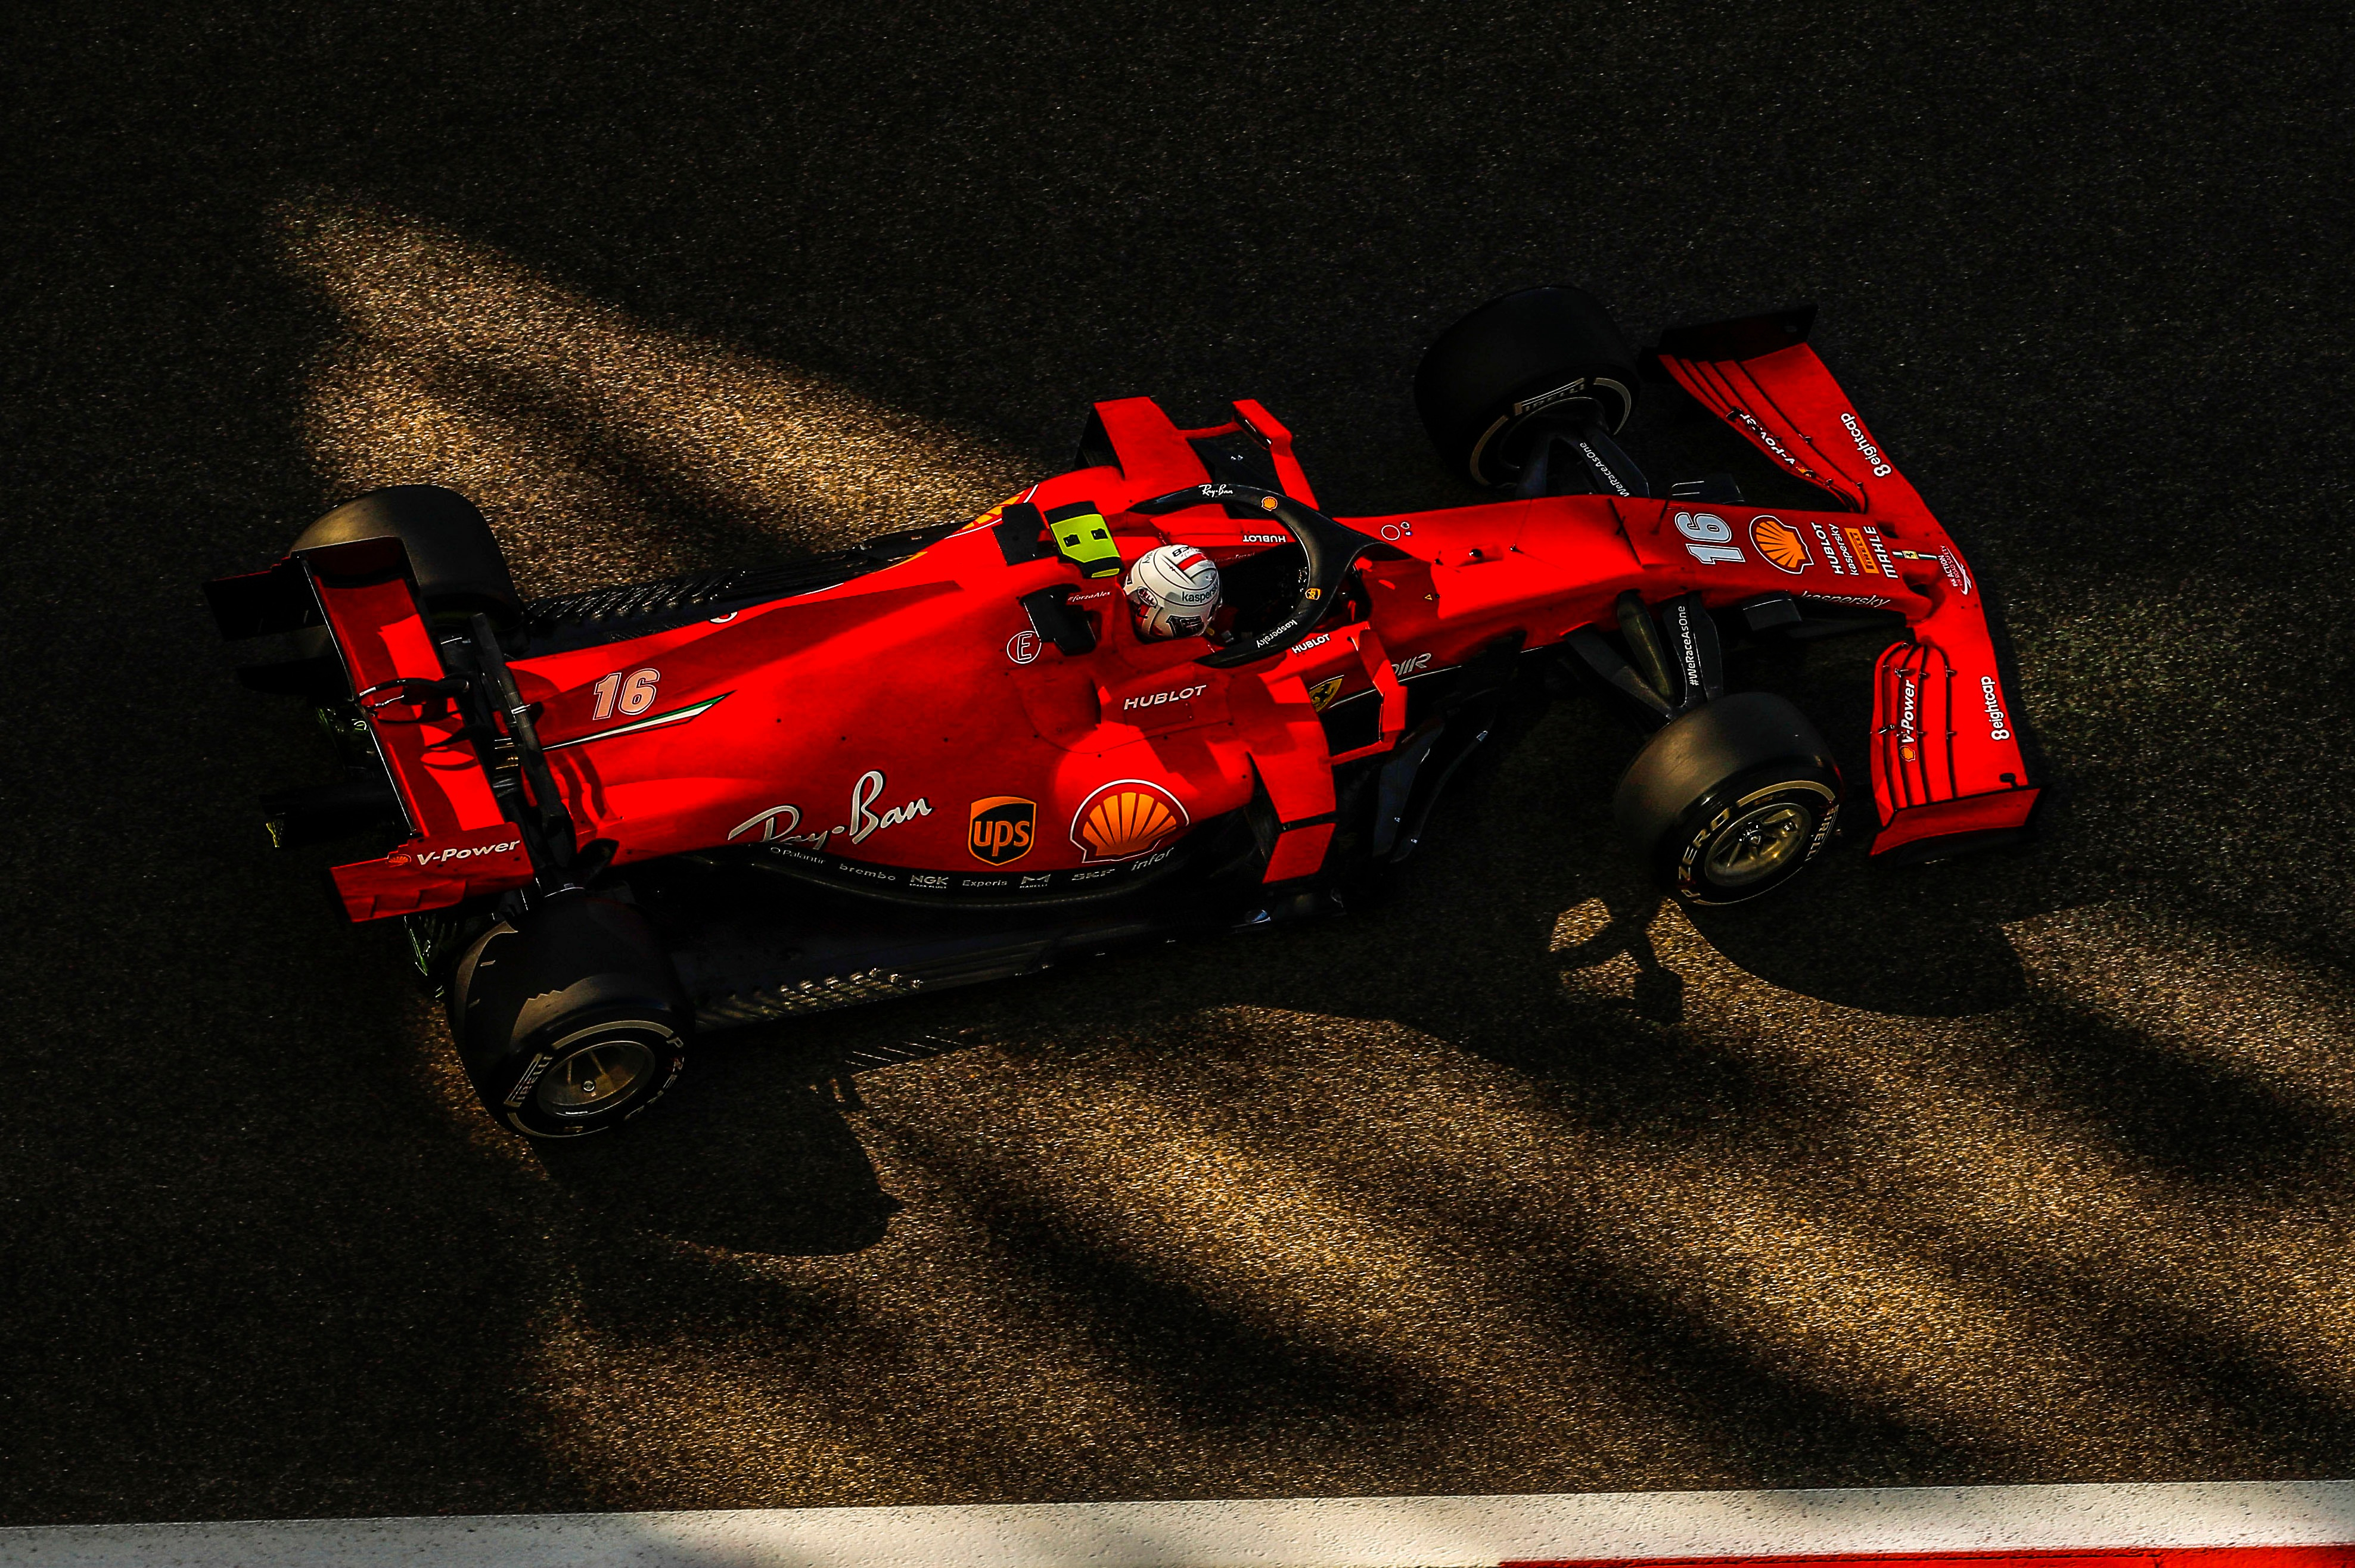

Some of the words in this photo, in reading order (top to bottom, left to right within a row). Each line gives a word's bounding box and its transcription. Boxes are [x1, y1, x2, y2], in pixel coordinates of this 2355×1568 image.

[1198, 484, 1233, 497] Ray-Ban
[1675, 512, 1745, 564] 16
[1811, 522, 1844, 574] HUBLOT
[1828, 524, 1859, 575] kaspersky
[1848, 531, 1875, 570] PIRELLI
[1863, 526, 1898, 578] MAHLE
[1938, 555, 1954, 577] ACTION
[1256, 619, 1298, 648] kaspersky
[1292, 633, 1331, 654] HUBLOT
[1679, 606, 1700, 686] #WeRaceAsOne
[593, 668, 660, 720] 16
[1124, 685, 1207, 710] HUBLOT
[1901, 679, 1915, 743] V-Power
[728, 771, 933, 850] Ray-Ban
[417, 839, 520, 866] V-Power
[973, 820, 1030, 857] ups
[783, 850, 826, 864] Palantir
[839, 863, 896, 881] brembo
[1131, 847, 1174, 871] infor
[910, 875, 949, 885] NGK
